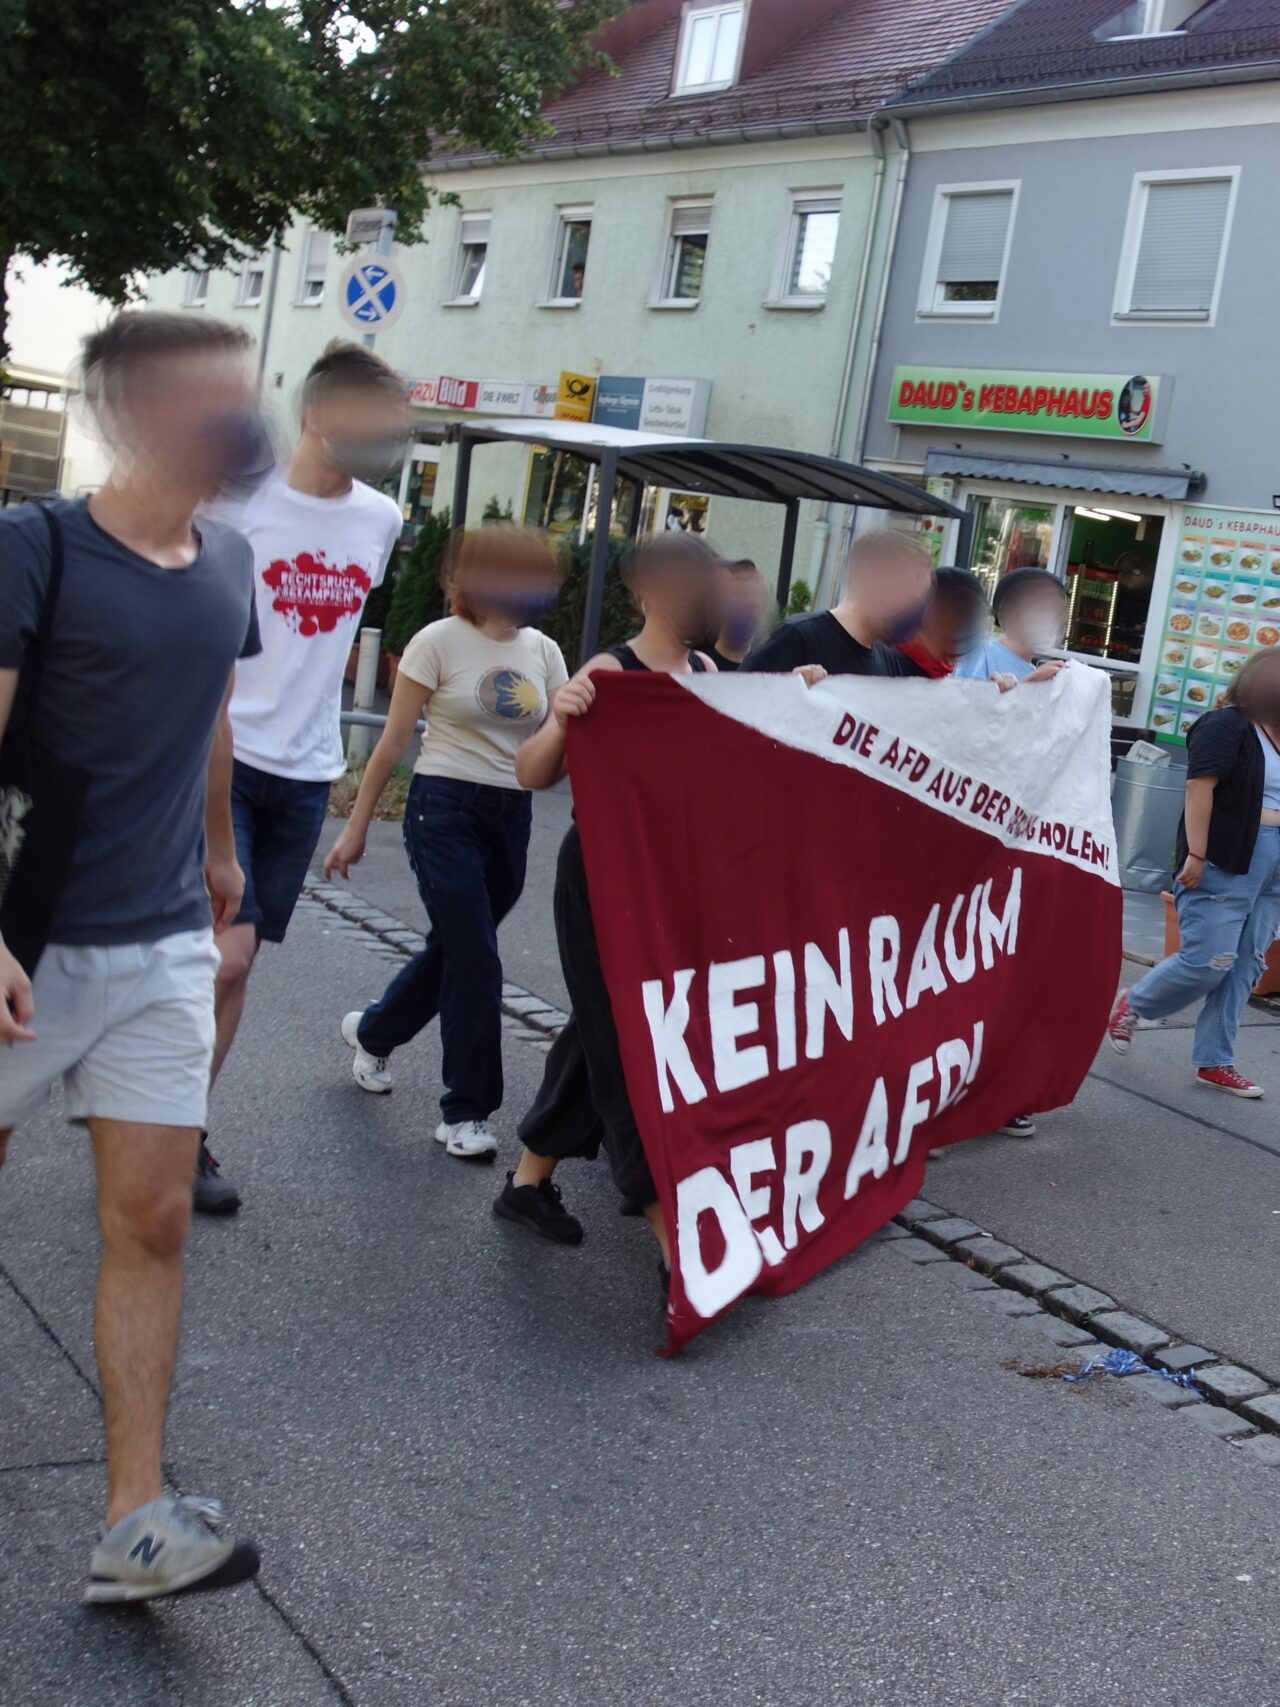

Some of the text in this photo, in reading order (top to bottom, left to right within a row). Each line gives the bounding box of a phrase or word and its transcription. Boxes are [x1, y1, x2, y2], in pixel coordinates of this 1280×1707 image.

[438, 377, 467, 407] Bild
[978, 383, 1115, 419] KEBAPHAUS
[1184, 515, 1213, 529] DAUD
[832, 711, 880, 758] DIE
[879, 736, 931, 783] AFD
[926, 766, 972, 807] AUS
[969, 782, 1011, 826] DER
[1037, 820, 1111, 871] HOLEN!
[642, 866, 1022, 1114] KEIN RAUM
[676, 1020, 985, 1318] DER AFD!
